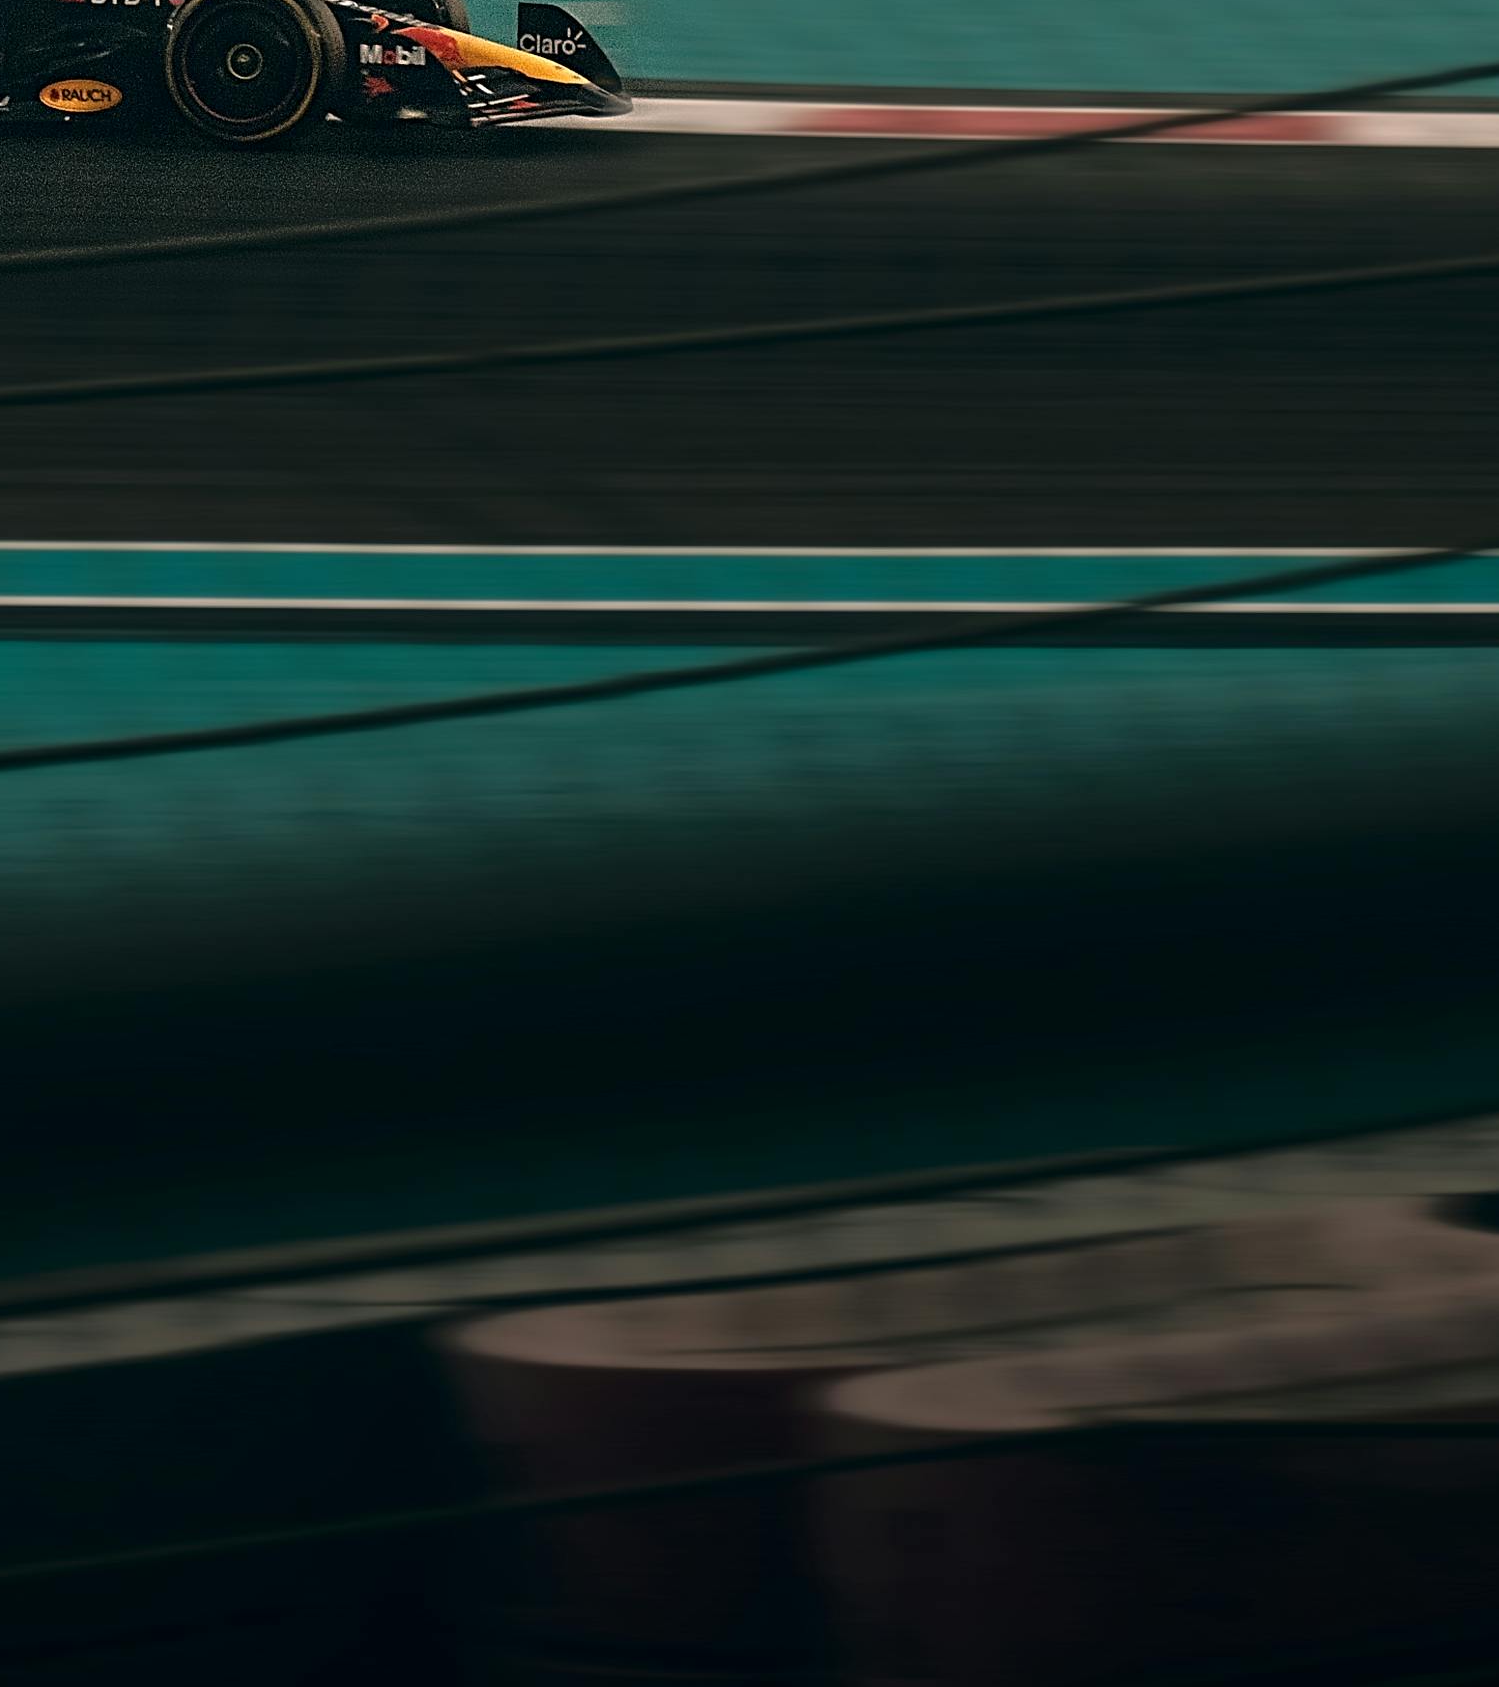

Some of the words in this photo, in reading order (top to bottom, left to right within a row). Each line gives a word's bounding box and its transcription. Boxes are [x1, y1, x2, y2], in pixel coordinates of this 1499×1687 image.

[359, 43, 426, 66] Mobil
[519, 33, 577, 56] Claro
[61, 88, 111, 102] RAUCH
